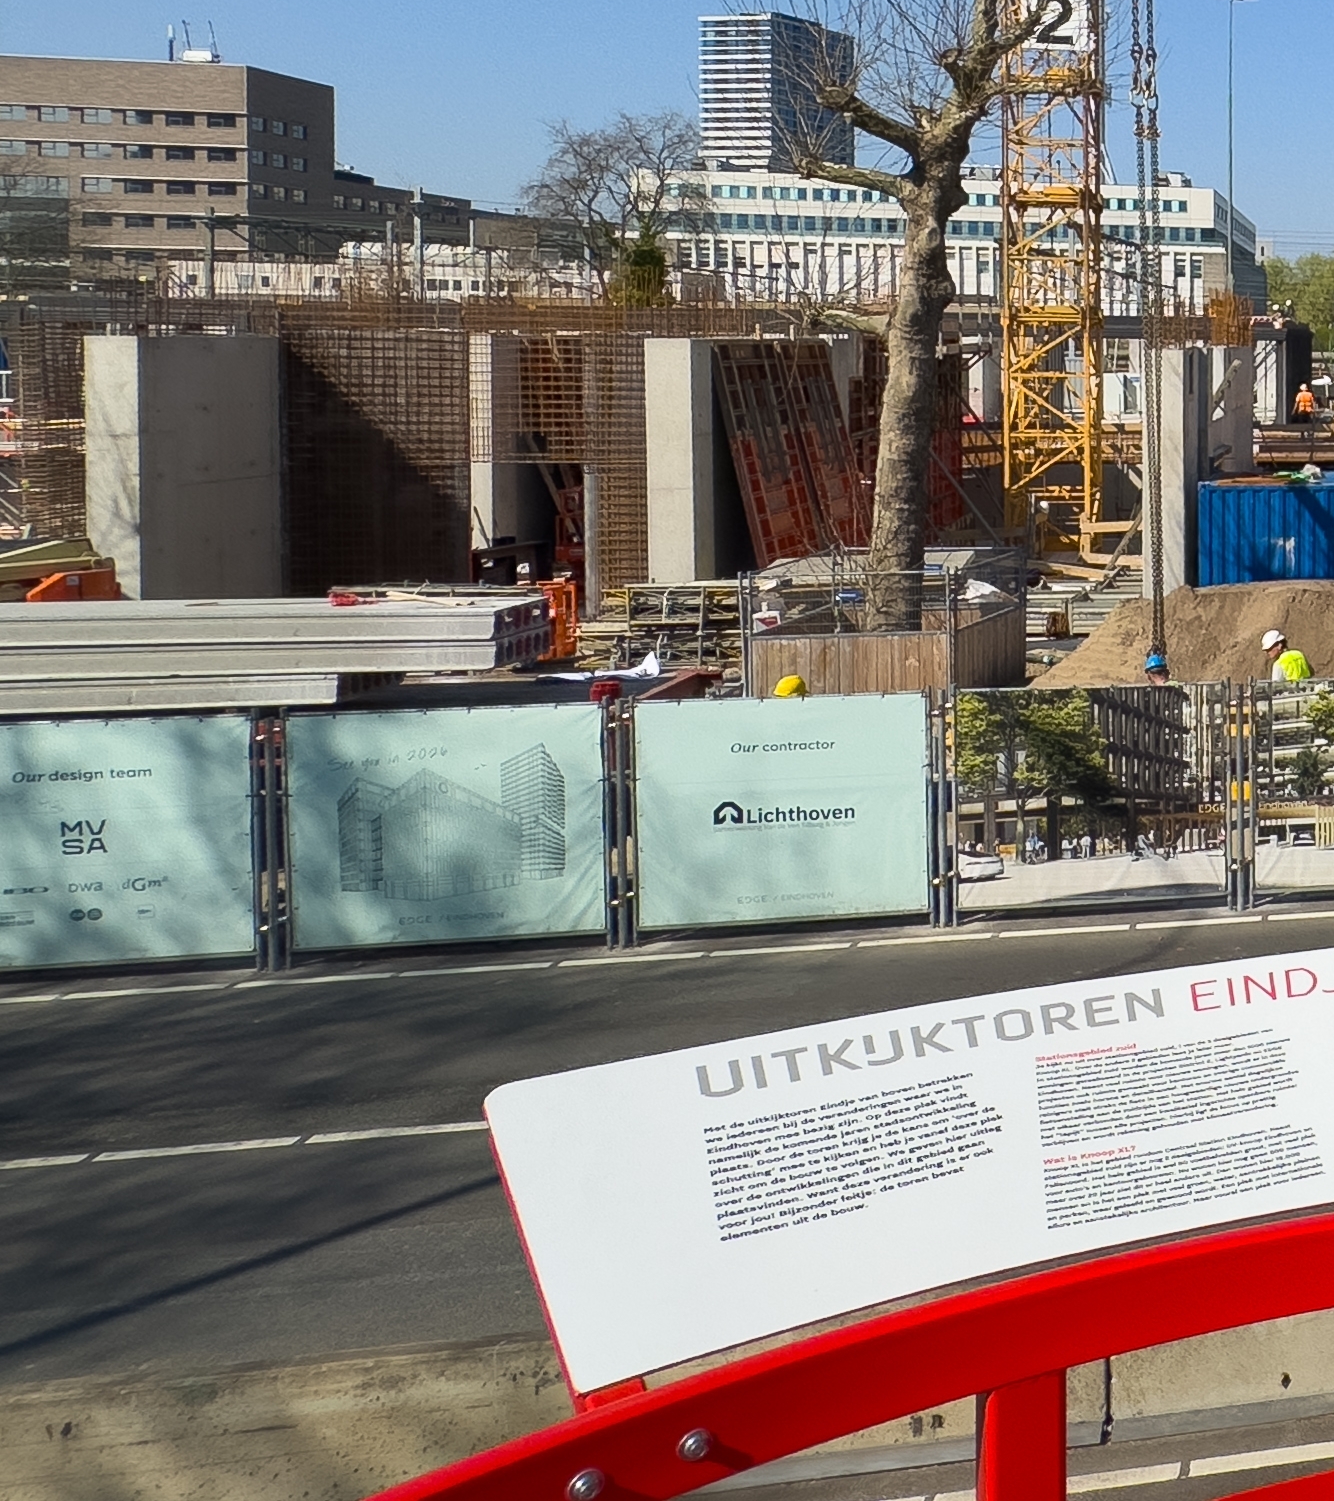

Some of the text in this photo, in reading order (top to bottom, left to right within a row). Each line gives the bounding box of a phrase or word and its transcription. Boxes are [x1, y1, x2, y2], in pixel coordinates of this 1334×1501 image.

[12, 766, 153, 784] Our design team
[406, 745, 449, 761] 2026
[730, 739, 836, 754] Our contractor
[60, 819, 107, 837] MV
[746, 806, 856, 824] Lichthoven
[61, 837, 108, 855] SA
[695, 988, 1165, 1098] UITKIJKTOREN
[703, 1072, 973, 1134] Met de uitkijktoren Eindje van boven betrekken
[704, 1136, 724, 1144] we
[726, 1125, 780, 1140] iedereen
[782, 1119, 798, 1129] bij
[818, 1099, 901, 1121] veranderingen
[903, 1091, 931, 1102] waar
[933, 1087, 950, 1095] we
[706, 1092, 969, 1155] Eindhoven mee bezig zijn. Op deze plek vindt
[708, 1101, 977, 1165] namelijk de komende jaren stadsontwikkeling
[709, 1163, 753, 1178] plaats.
[756, 1155, 786, 1166] Door
[788, 1151, 805, 1160] de
[806, 1144, 840, 1155] toren
[841, 1136, 869, 1147] krijg
[871, 1133, 883, 1142] je
[884, 1129, 900, 1137] de
[901, 1123, 930, 1133] kans
[931, 1117, 950, 1126] om
[981, 1106, 996, 1114] de
[713, 1125, 1003, 1198] zicht om de bouw te volgen. We geven hier uitleg
[779, 1162, 806, 1173] mee
[823, 1144, 860, 1163] kijken
[862, 1141, 878, 1153] en
[879, 1138, 902, 1149] heb
[904, 1136, 916, 1145] je
[917, 1126, 949, 1140] vanaf
[951, 1121, 978, 1132] deze
[980, 1114, 1003, 1126] plek
[1043, 1156, 1065, 1165] Wat
[1080, 1149, 1116, 1160] Knoop
[714, 1197, 744, 1208] over
[746, 1193, 763, 1202] de
[765, 1171, 860, 1197] ontwikkelingen
[859, 1163, 881, 1175] die
[897, 1152, 914, 1166] dit
[913, 1146, 955, 1163] gebied
[957, 1140, 986, 1153] gaan
